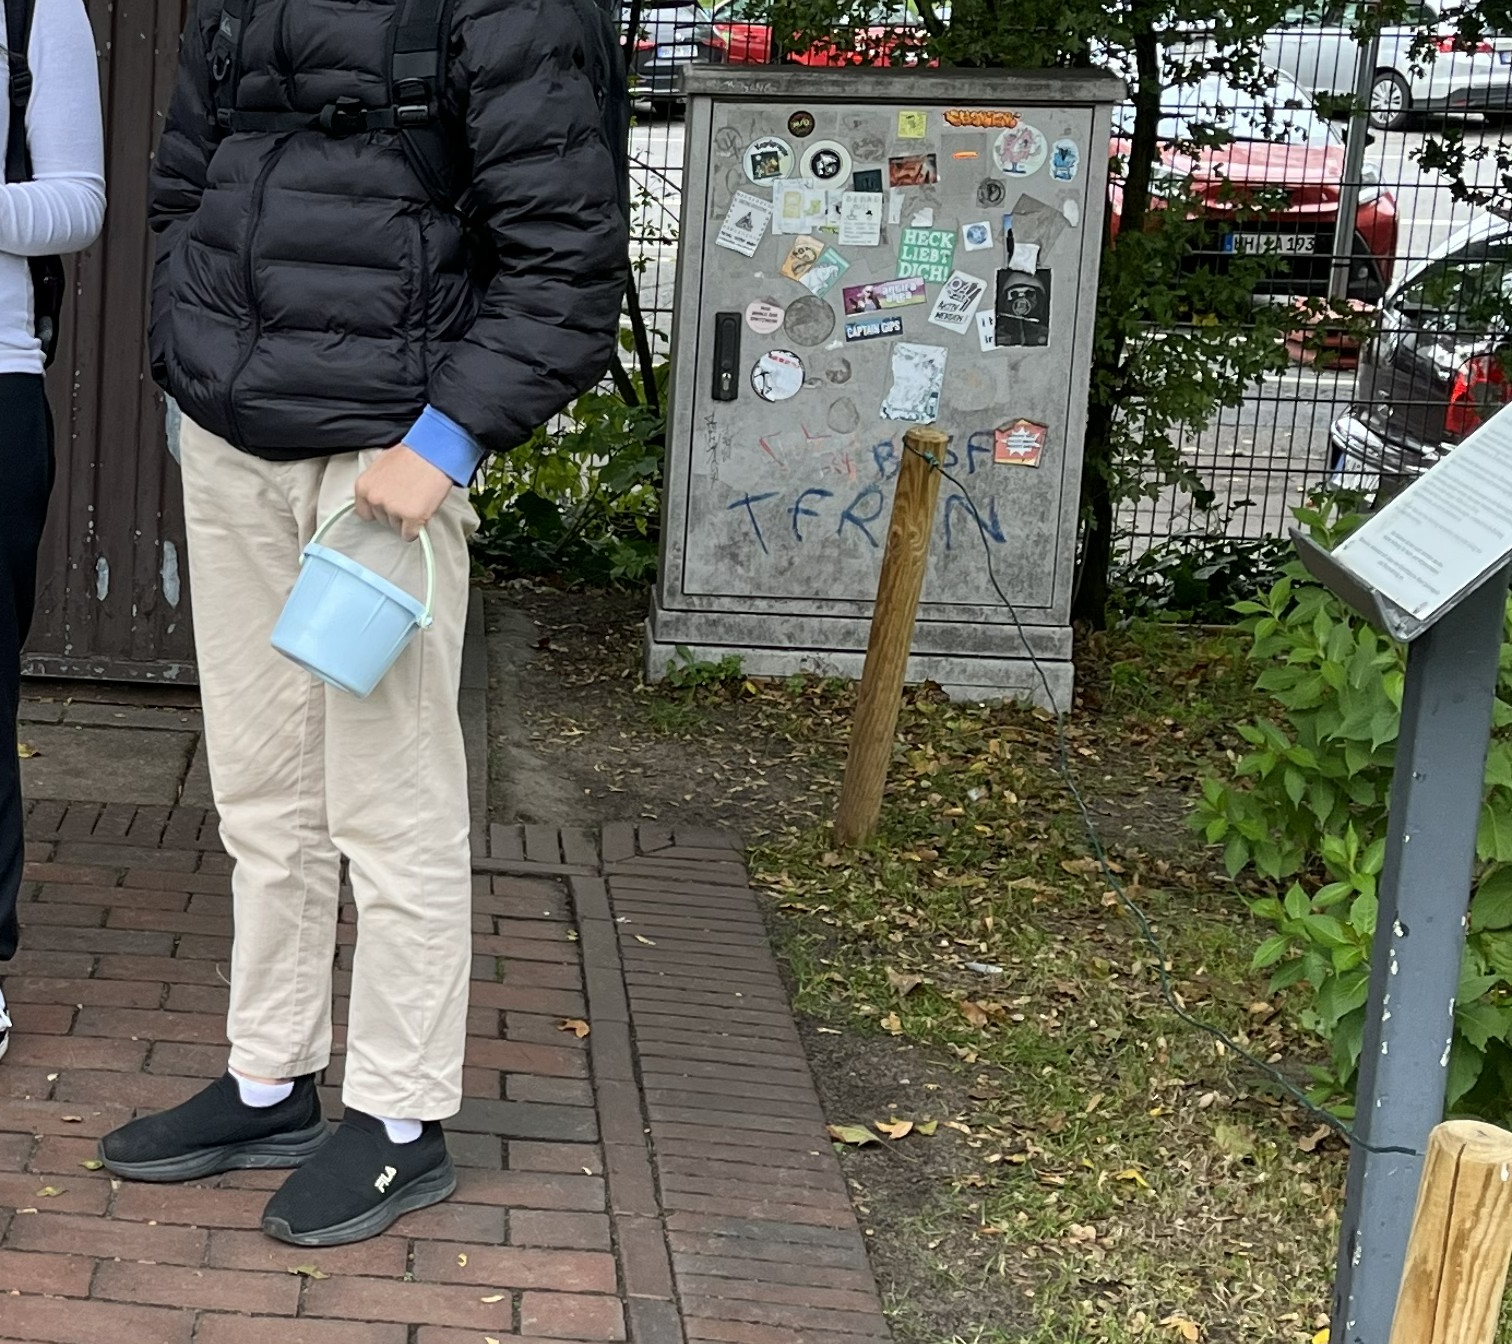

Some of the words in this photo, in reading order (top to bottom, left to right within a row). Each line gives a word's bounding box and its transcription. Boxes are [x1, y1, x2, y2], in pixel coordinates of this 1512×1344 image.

[903, 228, 956, 249] HECK
[900, 244, 951, 264] LIEBT
[898, 260, 949, 283] DICH!
[845, 323, 881, 339] CAPTAIN
[373, 1165, 397, 1194] FILA
